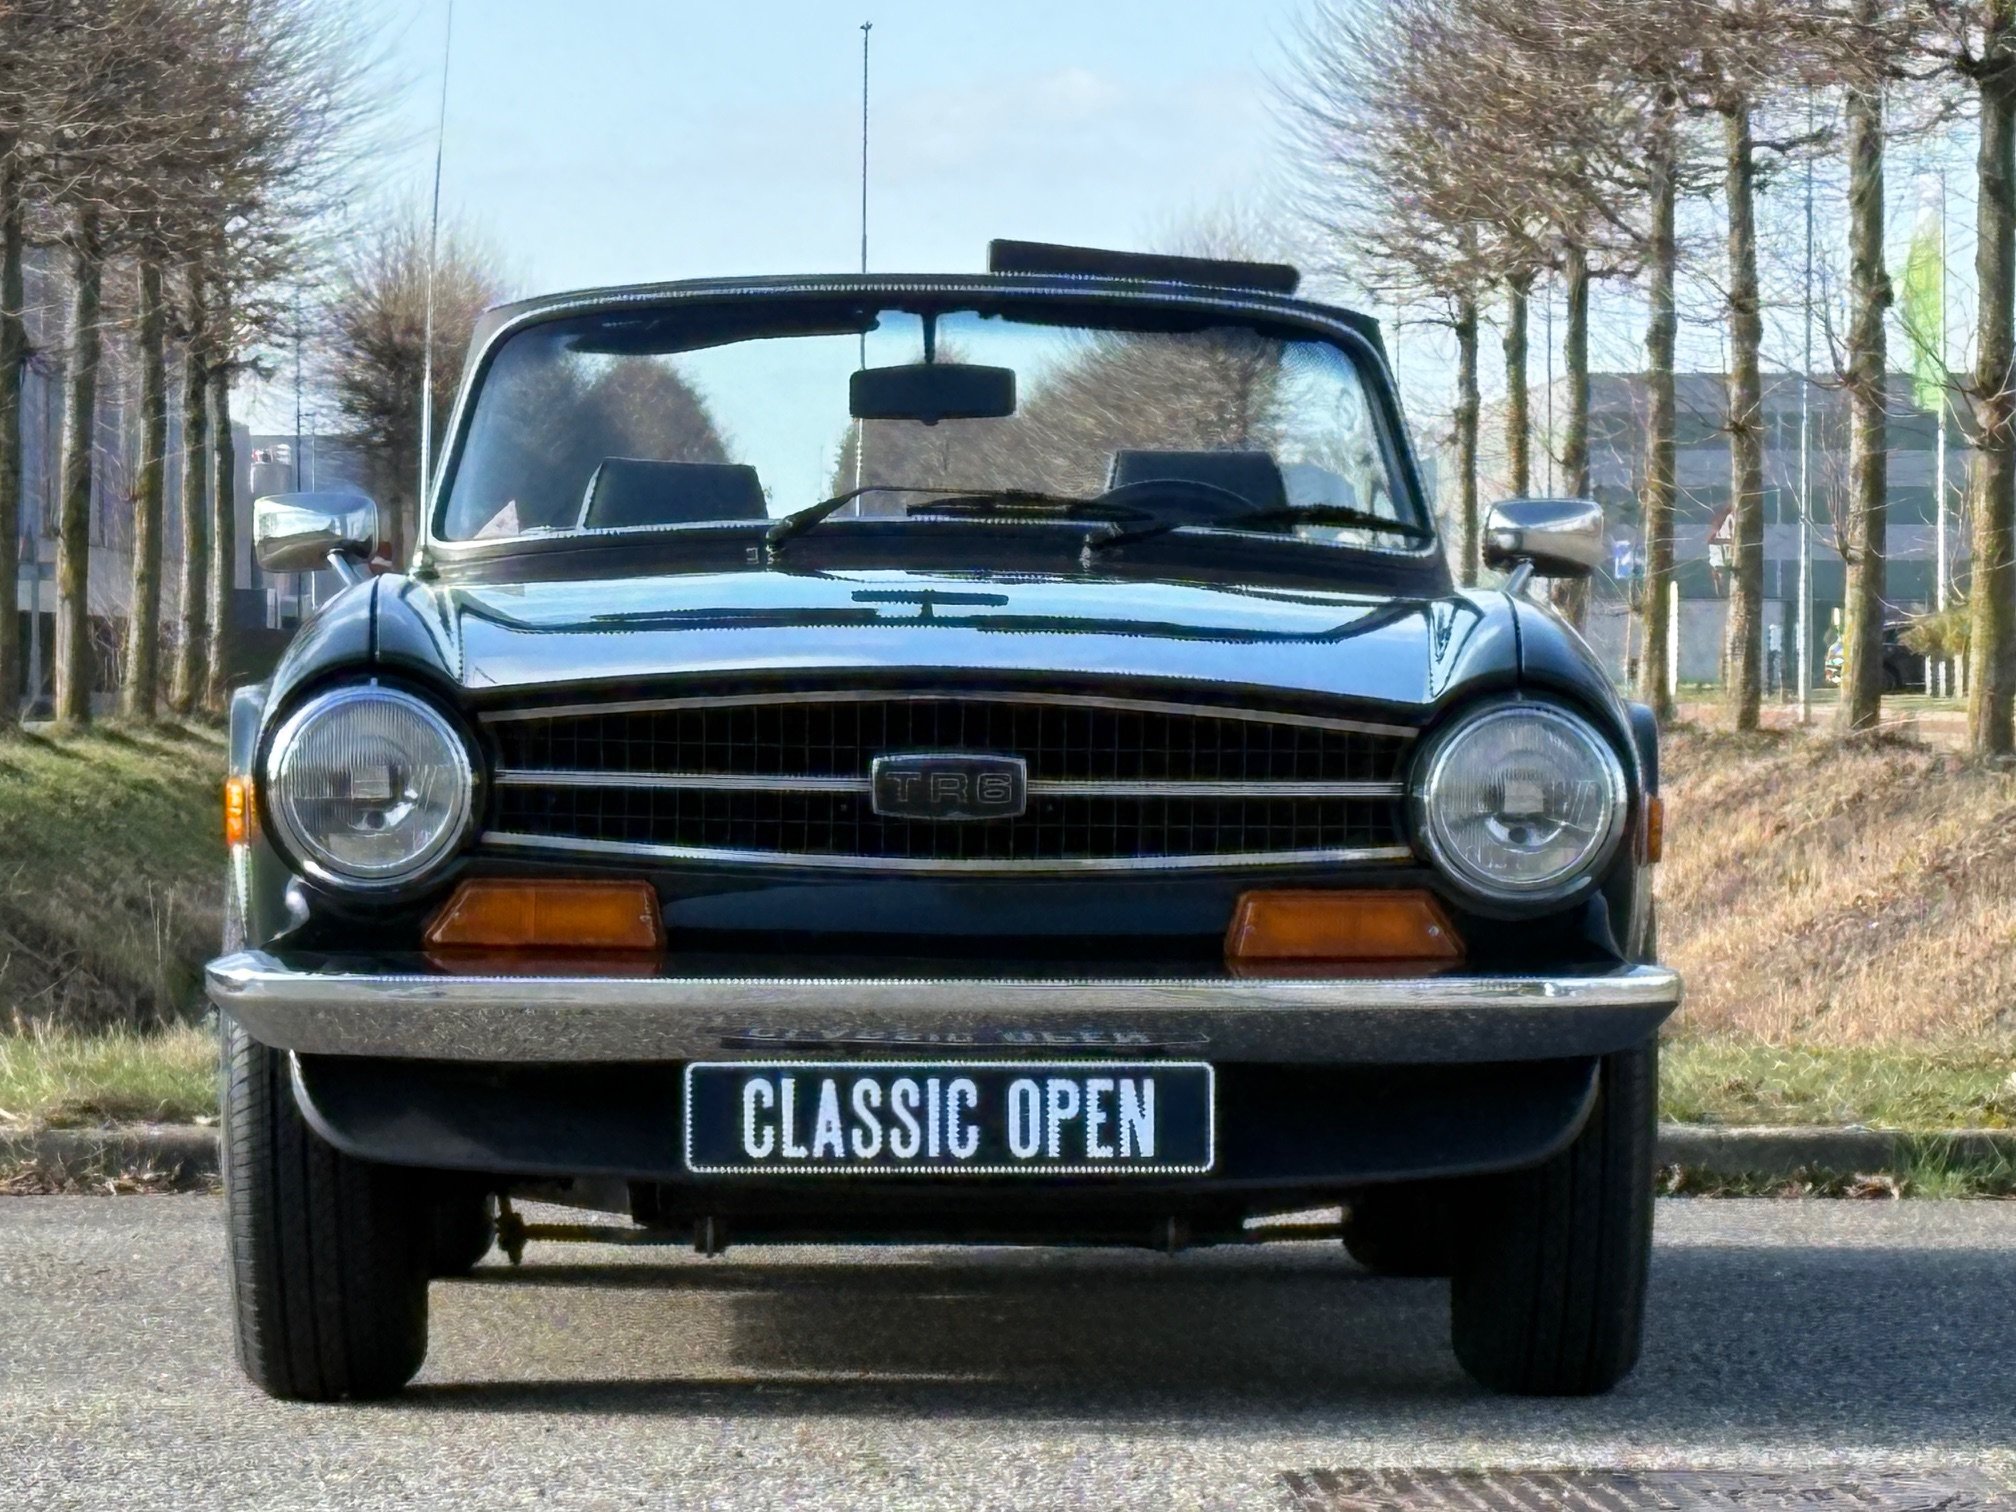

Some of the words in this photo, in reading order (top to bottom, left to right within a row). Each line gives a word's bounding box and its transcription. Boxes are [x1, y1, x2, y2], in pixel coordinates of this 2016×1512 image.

[885, 771, 1012, 804] TR6
[742, 1077, 980, 1159] CLASSIC
[1007, 1077, 1156, 1158] OPEN
